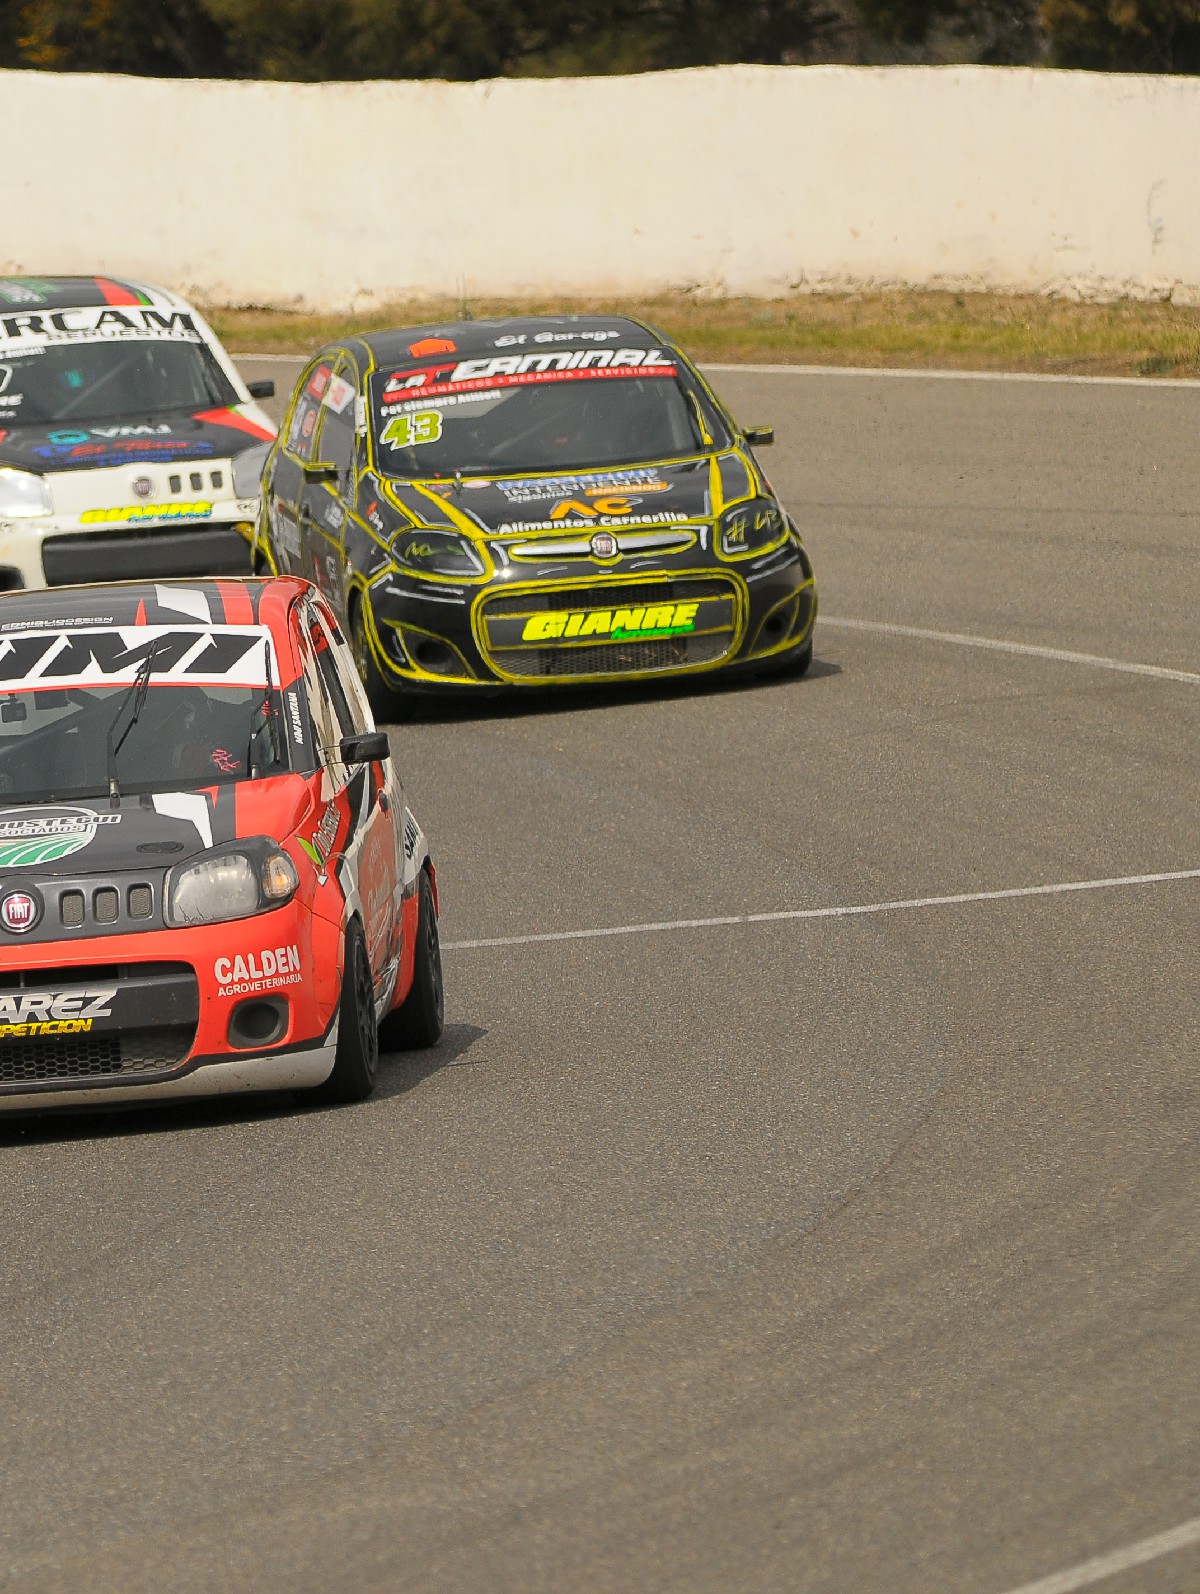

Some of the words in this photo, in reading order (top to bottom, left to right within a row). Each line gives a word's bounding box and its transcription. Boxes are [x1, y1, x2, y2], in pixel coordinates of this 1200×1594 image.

[380, 408, 443, 452] 43
[498, 517, 594, 535] Alimentos
[522, 603, 700, 641] GIANRE
[8, 902, 30, 920] FIAT
[214, 944, 301, 984] CALDEN
[217, 972, 303, 997] AGROVETERINARIA
